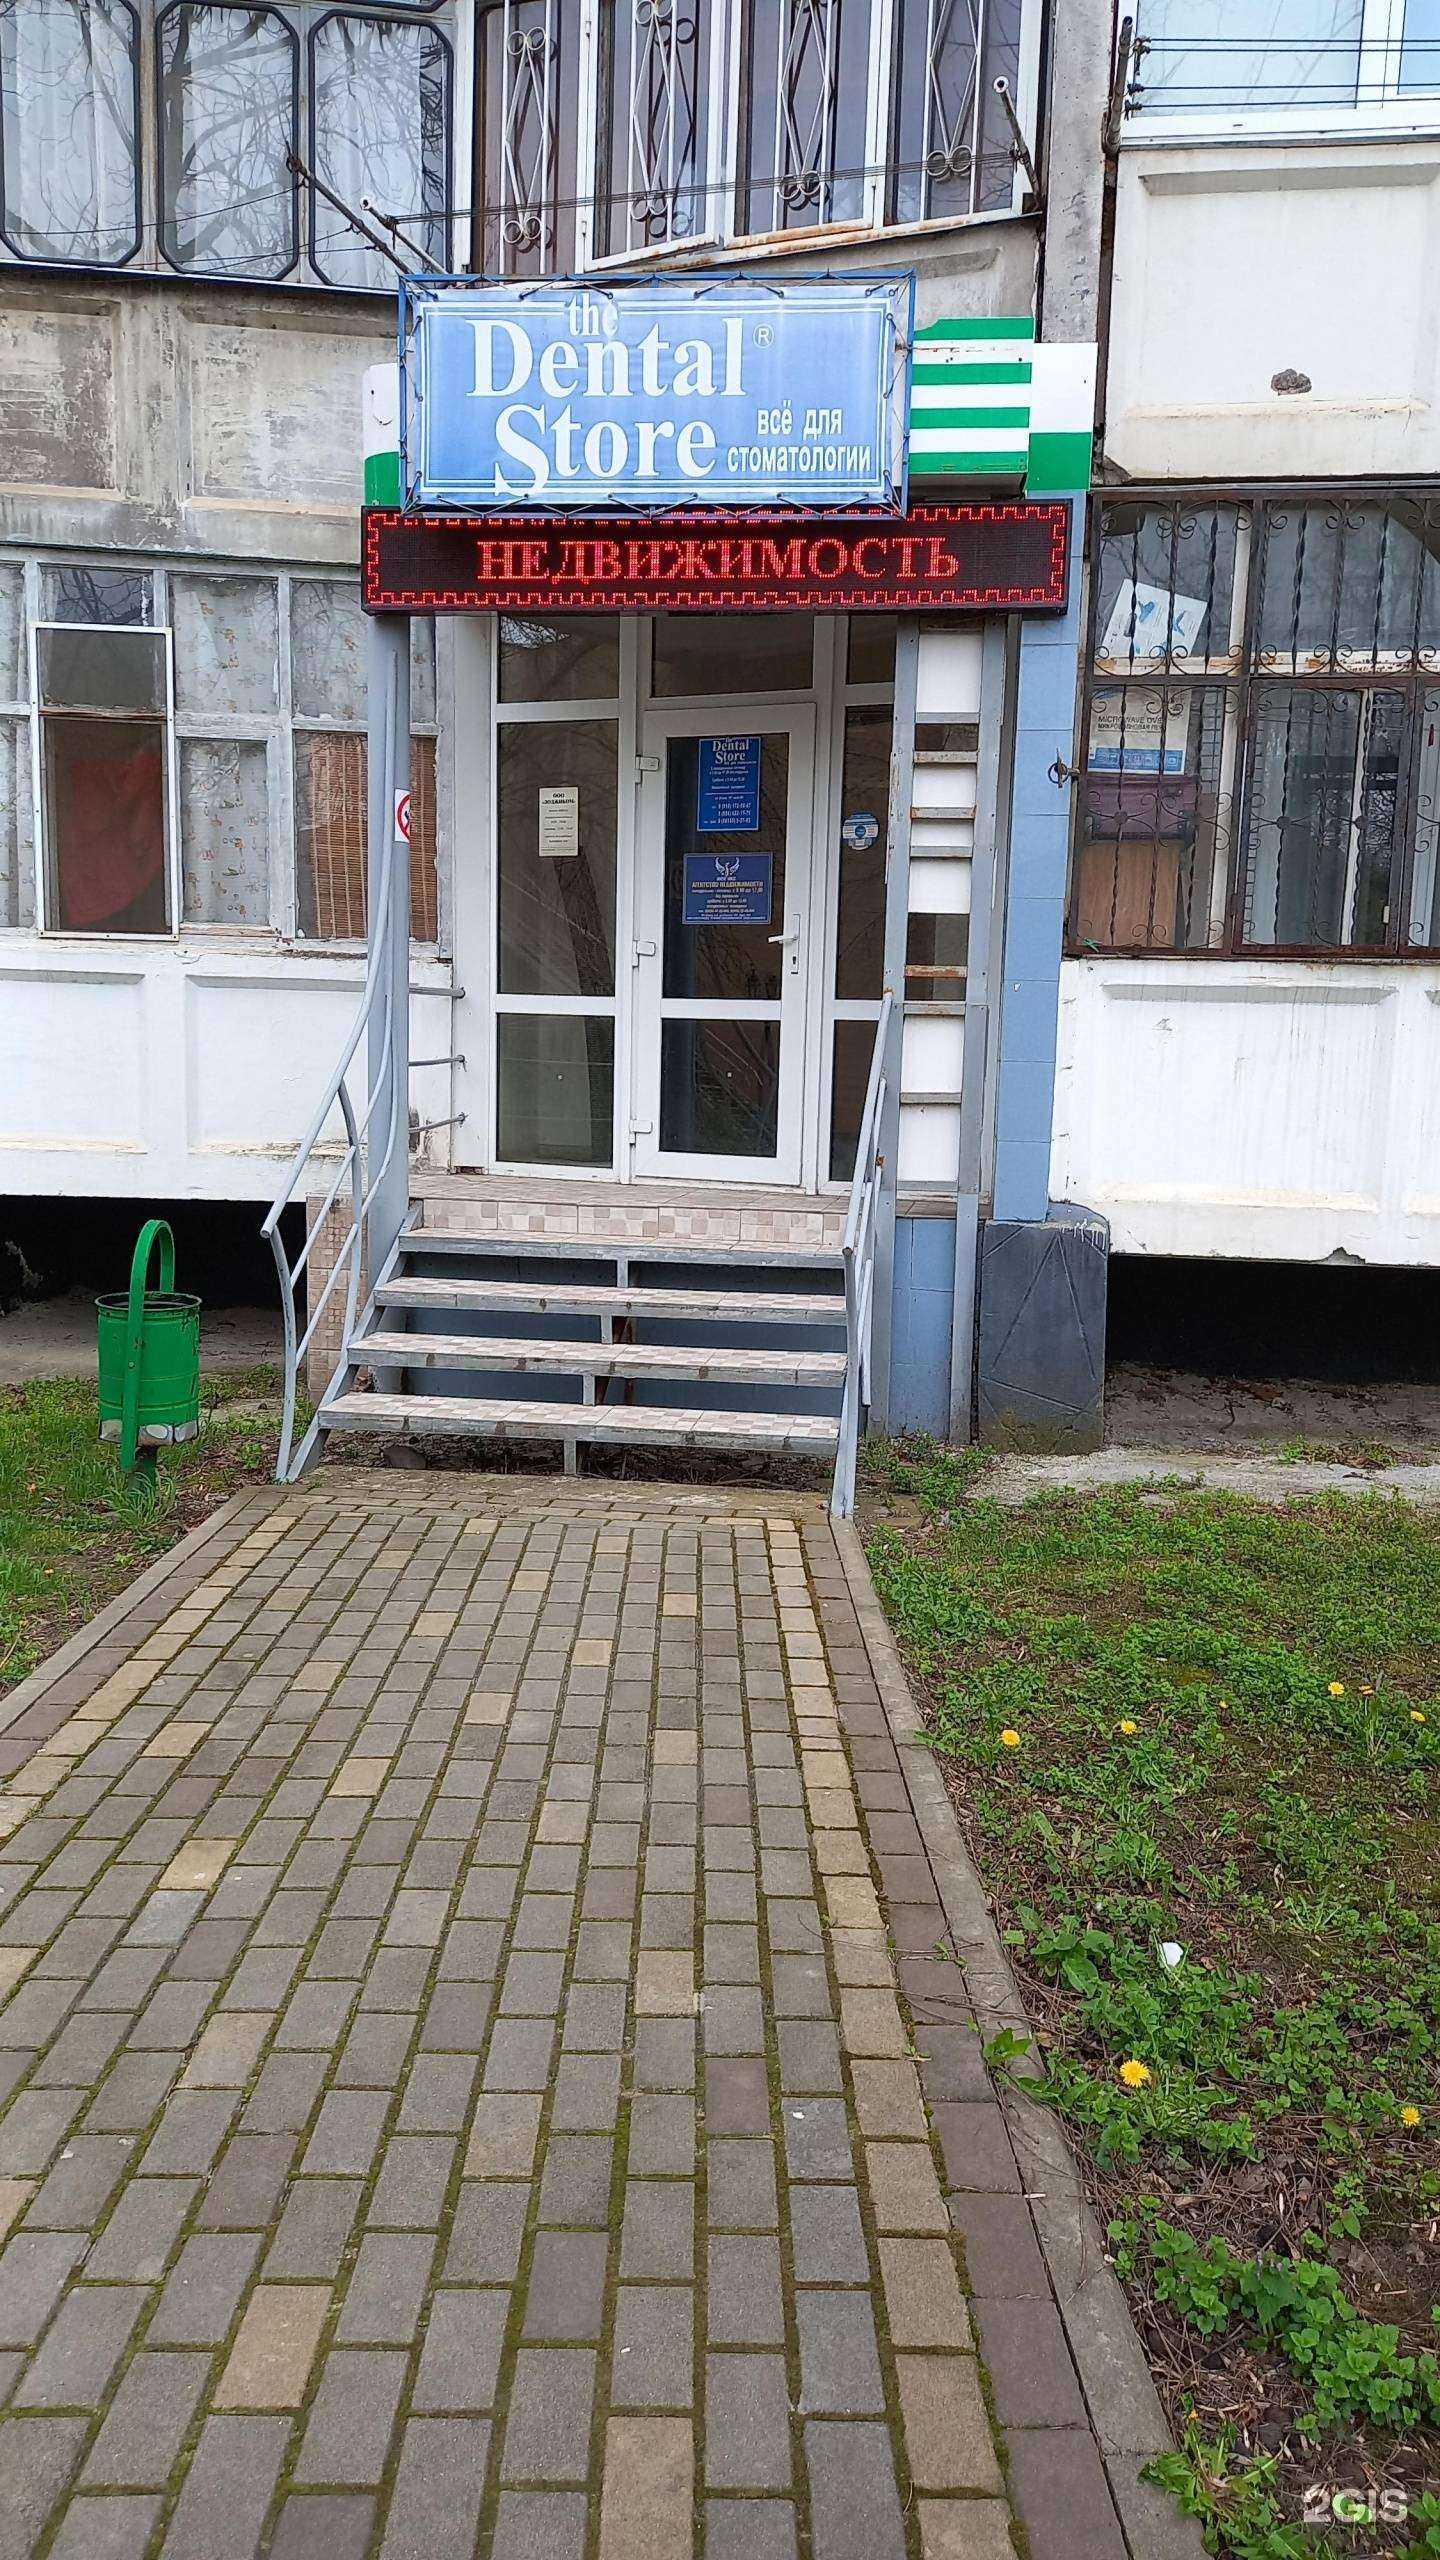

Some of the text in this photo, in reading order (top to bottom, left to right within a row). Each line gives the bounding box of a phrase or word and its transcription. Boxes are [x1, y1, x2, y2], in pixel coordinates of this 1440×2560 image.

[567, 292, 620, 337] the
[465, 317, 747, 399] Dental
[756, 400, 843, 441] всё для
[494, 403, 718, 497] Store
[727, 446, 871, 473] стоматологии
[477, 537, 960, 585] НЕДВИЖИМОСТЬ
[1147, 714, 1163, 724] OVE
[712, 739, 750, 751] Dental
[715, 750, 746, 764] Store
